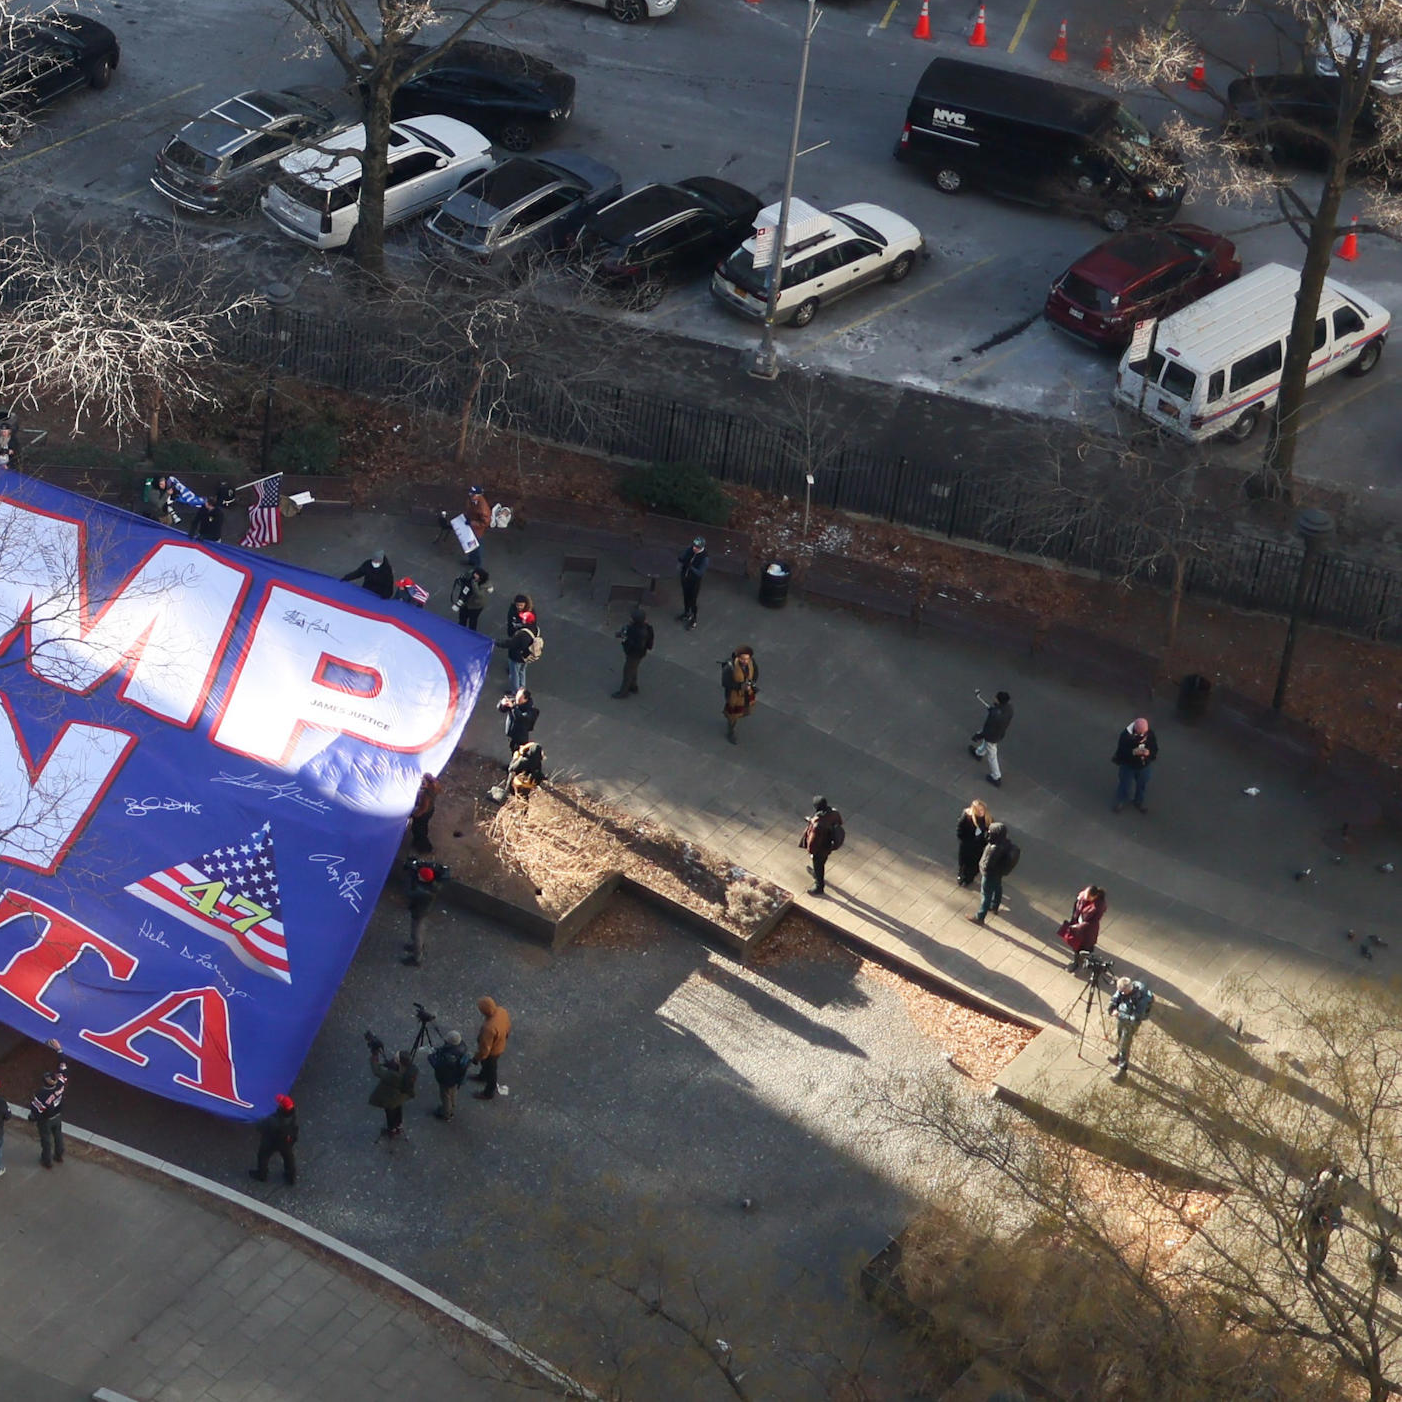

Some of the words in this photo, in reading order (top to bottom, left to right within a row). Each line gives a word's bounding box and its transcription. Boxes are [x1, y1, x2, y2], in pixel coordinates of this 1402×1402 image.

[933, 108, 966, 125] NYC
[309, 698, 346, 715] JAMES
[346, 708, 391, 732] JUSTICE
[180, 878, 273, 934] 47
